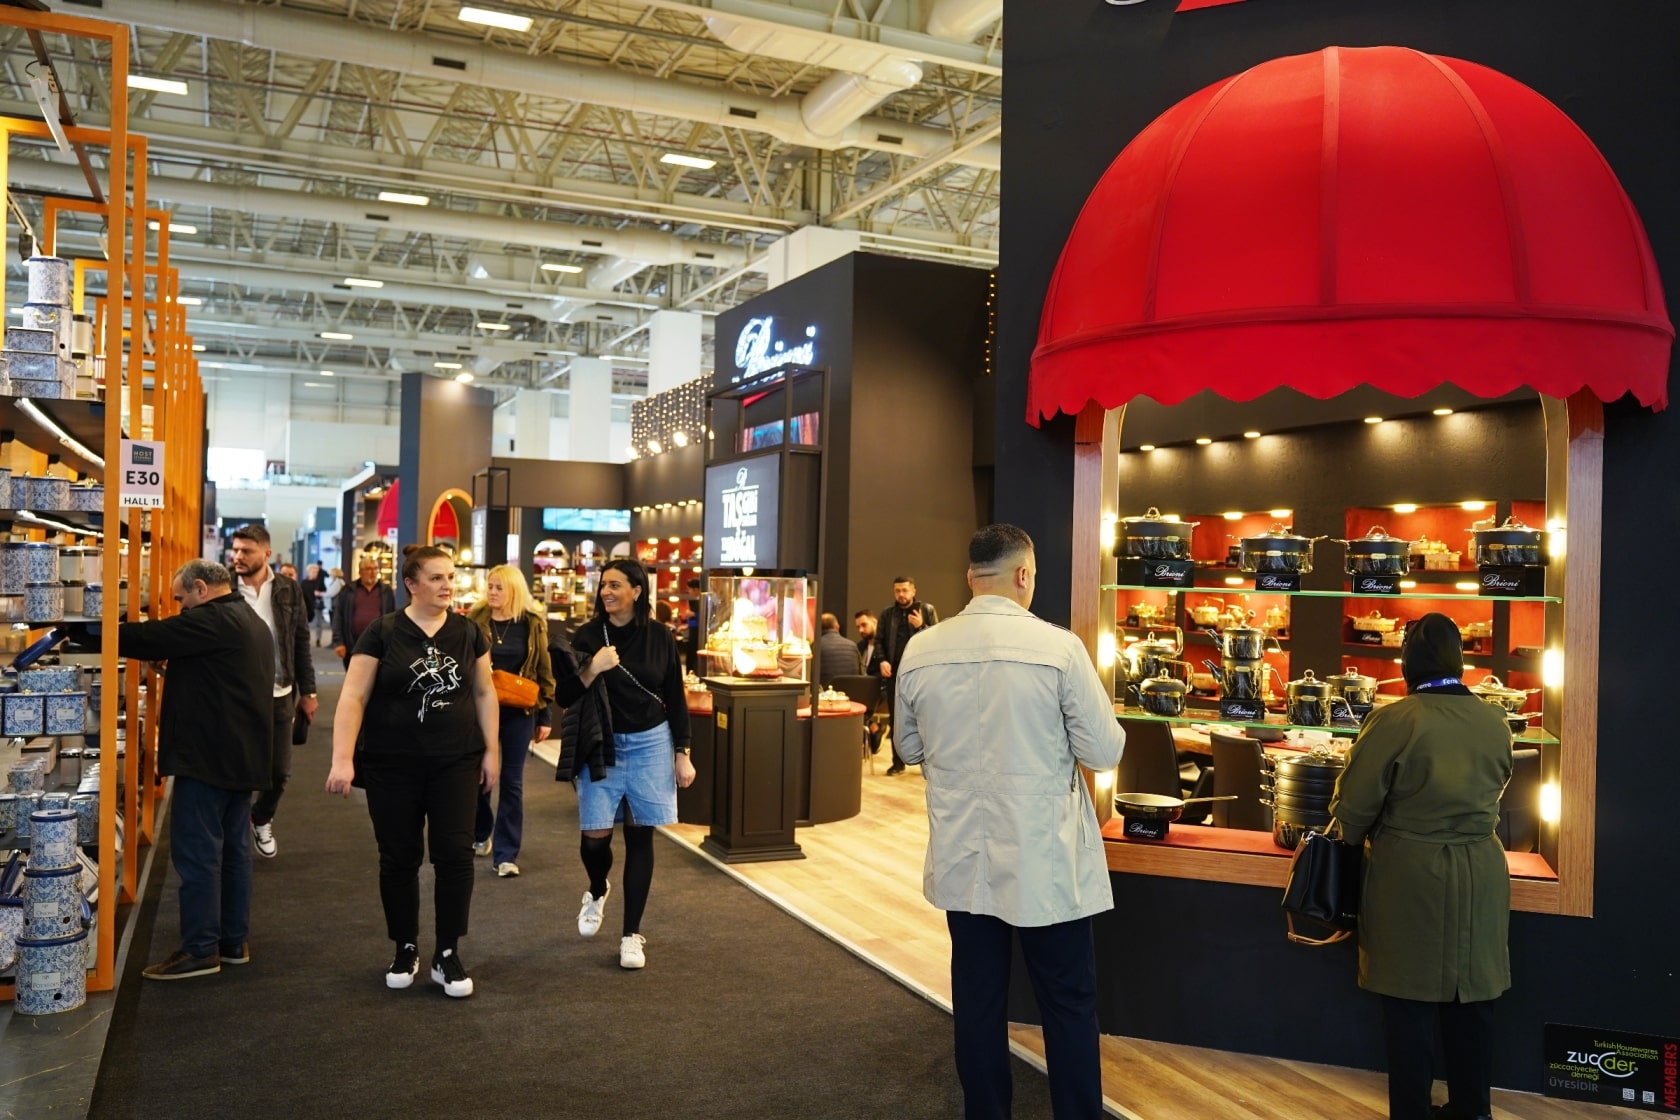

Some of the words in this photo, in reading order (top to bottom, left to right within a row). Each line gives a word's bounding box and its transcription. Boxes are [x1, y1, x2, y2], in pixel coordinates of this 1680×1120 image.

[126, 470, 160, 486] E30
[124, 497, 148, 505] HALL
[1154, 564, 1185, 578] Brioni
[1261, 575, 1292, 588] Brioni
[1360, 578, 1393, 590] Brioni
[1482, 573, 1519, 587] Brioni
[1227, 704, 1257, 715] Brioni
[1129, 822, 1158, 835] Brioni
[1594, 1040, 1616, 1049] Turkish
[1616, 1044, 1658, 1055] Housewares
[1616, 1049, 1659, 1060] Association
[1664, 1043, 1678, 1110] MEMBERS
[1549, 1077, 1599, 1092] ÜYESİDİR
